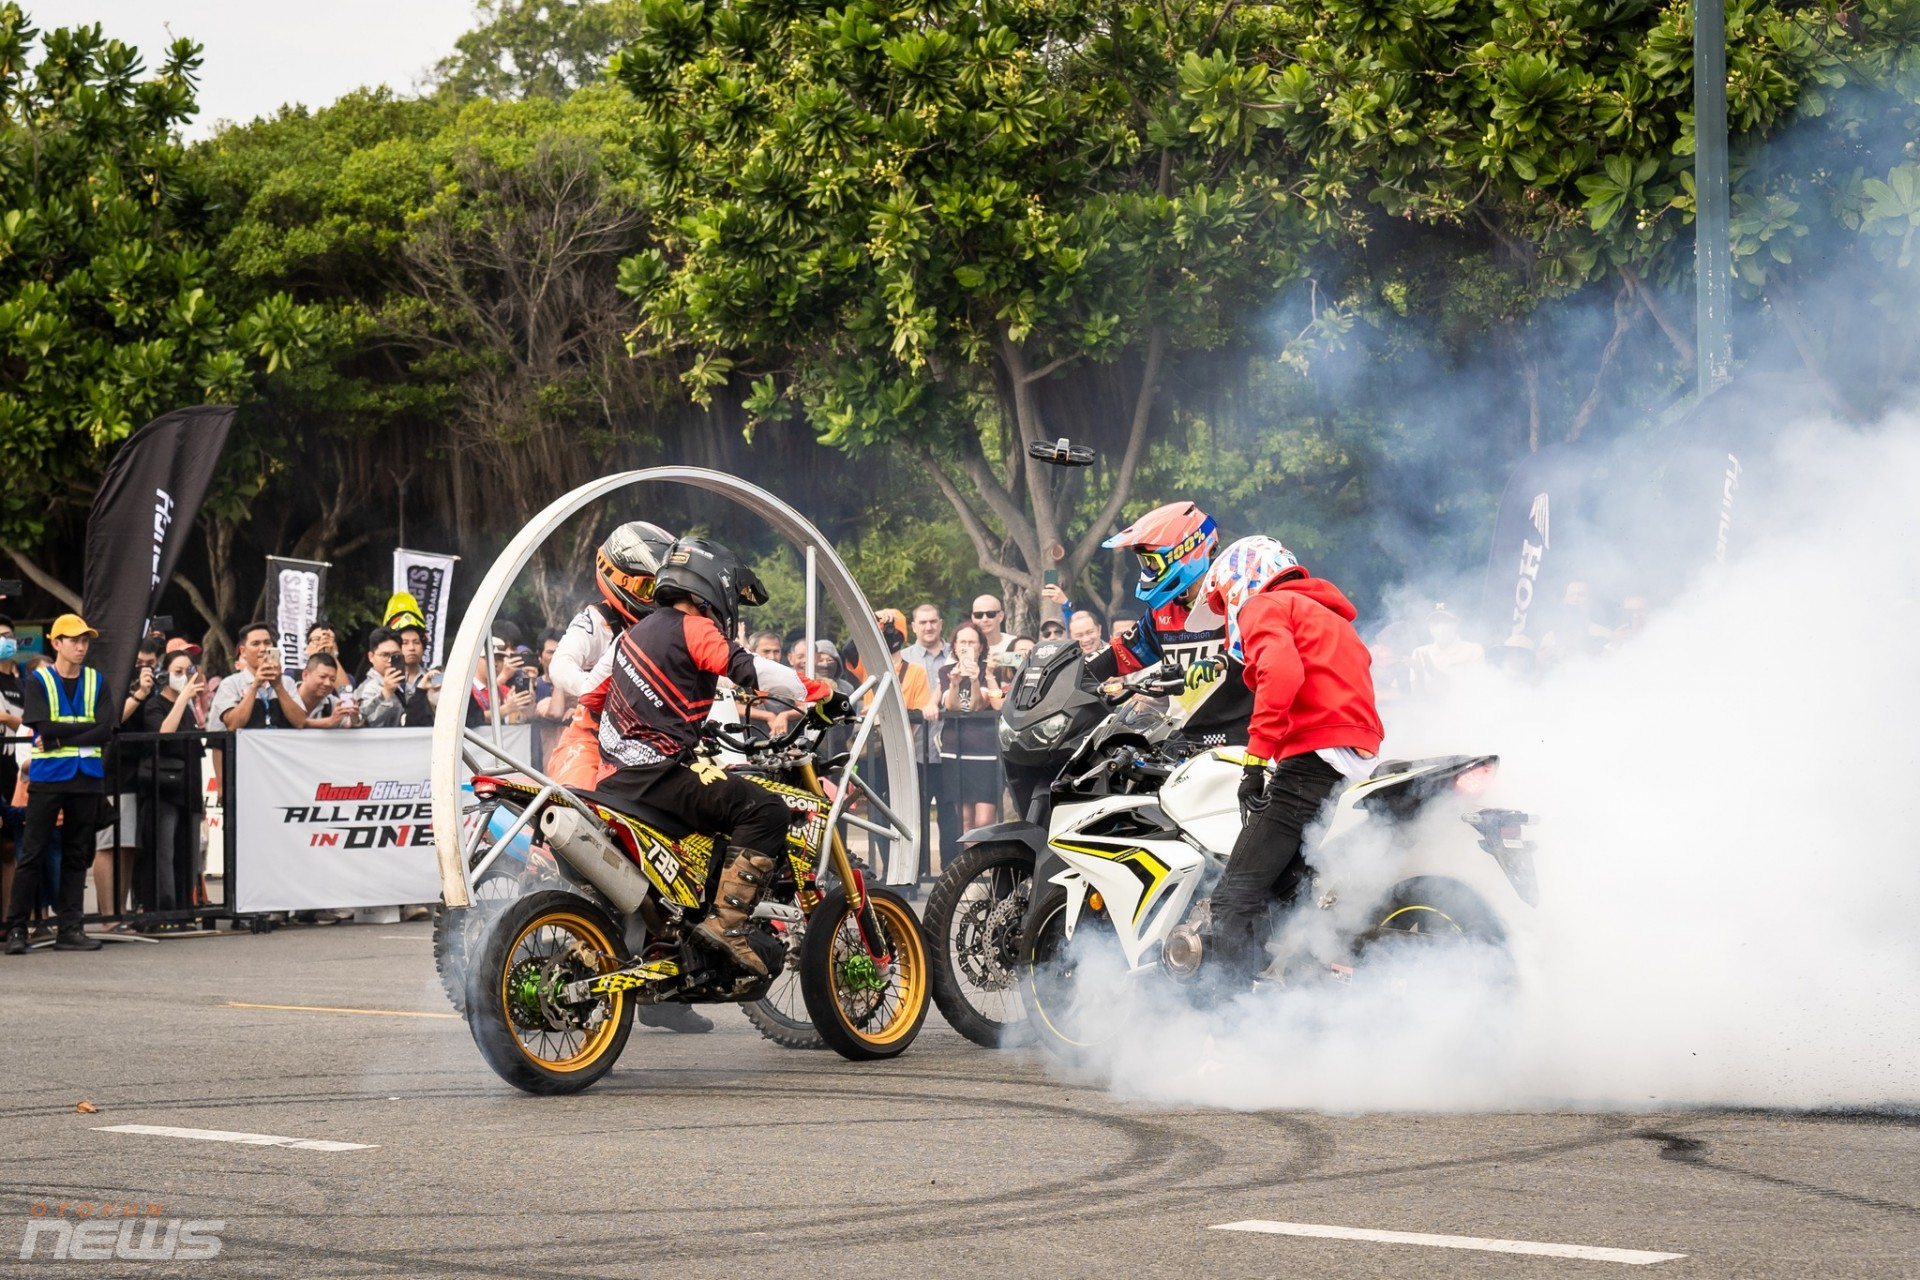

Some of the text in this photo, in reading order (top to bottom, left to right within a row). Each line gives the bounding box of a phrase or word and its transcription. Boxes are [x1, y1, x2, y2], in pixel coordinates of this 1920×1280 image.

[1165, 529, 1206, 564] 100%
[1511, 539, 1543, 637] HON
[1158, 616, 1172, 624] MX
[623, 663, 664, 708] Adventure
[315, 782, 372, 801] Honda
[371, 780, 420, 800] Biker
[274, 803, 432, 823] ALL RIDE
[783, 795, 818, 812] GON
[310, 833, 339, 847] IN
[647, 837, 680, 884] 735
